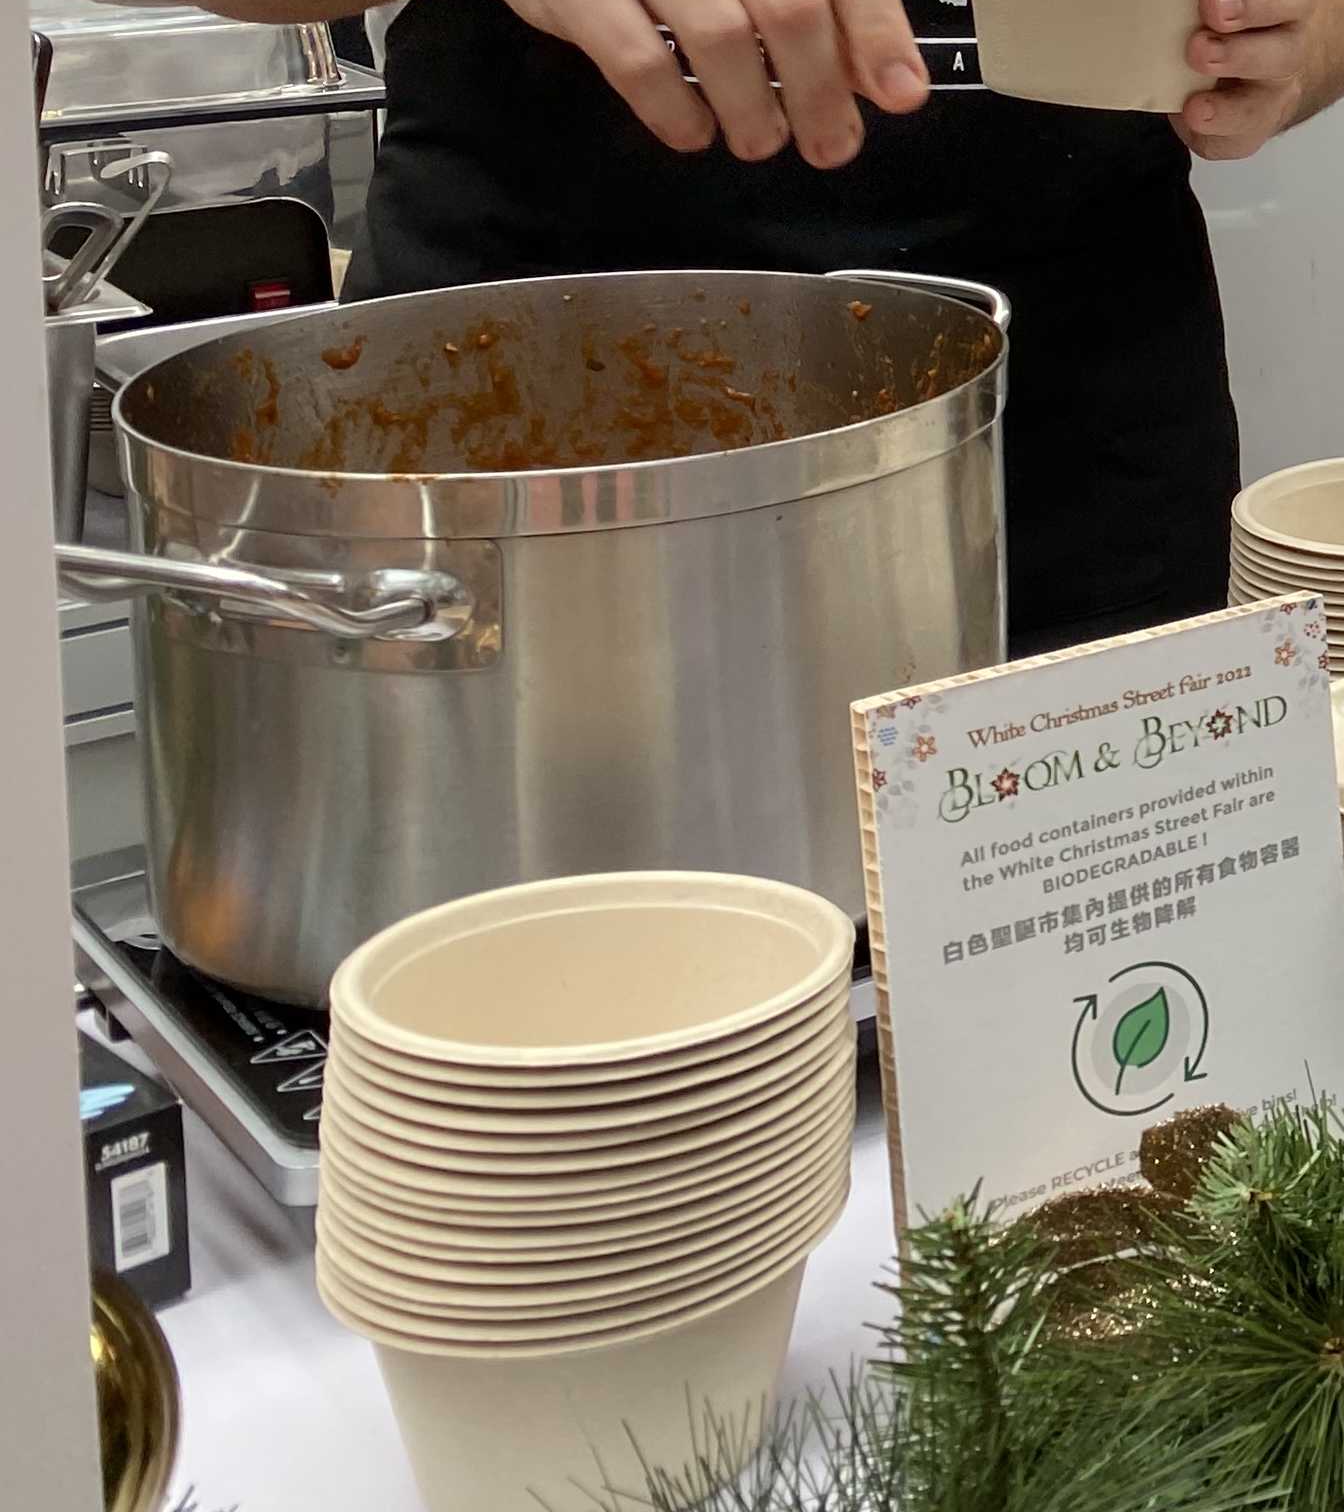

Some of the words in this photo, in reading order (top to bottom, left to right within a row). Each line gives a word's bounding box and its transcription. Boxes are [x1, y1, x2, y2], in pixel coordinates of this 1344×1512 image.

[967, 722, 1027, 750] White
[1029, 700, 1119, 735] Christmas
[1122, 682, 1176, 710] Street
[1178, 672, 1209, 696] Fair
[1215, 666, 1252, 686] 2022
[1092, 741, 1121, 774] &
[960, 846, 986, 868] All
[990, 832, 1034, 859] food
[1038, 806, 1135, 845] containers
[1138, 780, 1216, 820] provided
[1219, 764, 1275, 793] within
[962, 870, 995, 893] the
[999, 853, 1055, 882] White
[1059, 827, 1151, 864] Christmas
[1153, 808, 1209, 837] Street
[1212, 797, 1245, 819] Fair
[1248, 789, 1276, 809] are
[1042, 835, 1199, 895] BIODEGRADABLE
[1201, 831, 1209, 848] !
[942, 835, 1302, 966] 白色聖誕市集內提供的所有食物容器
[1062, 895, 1198, 956] 均可生物降解
[1050, 1150, 1126, 1190] RECYCLE
